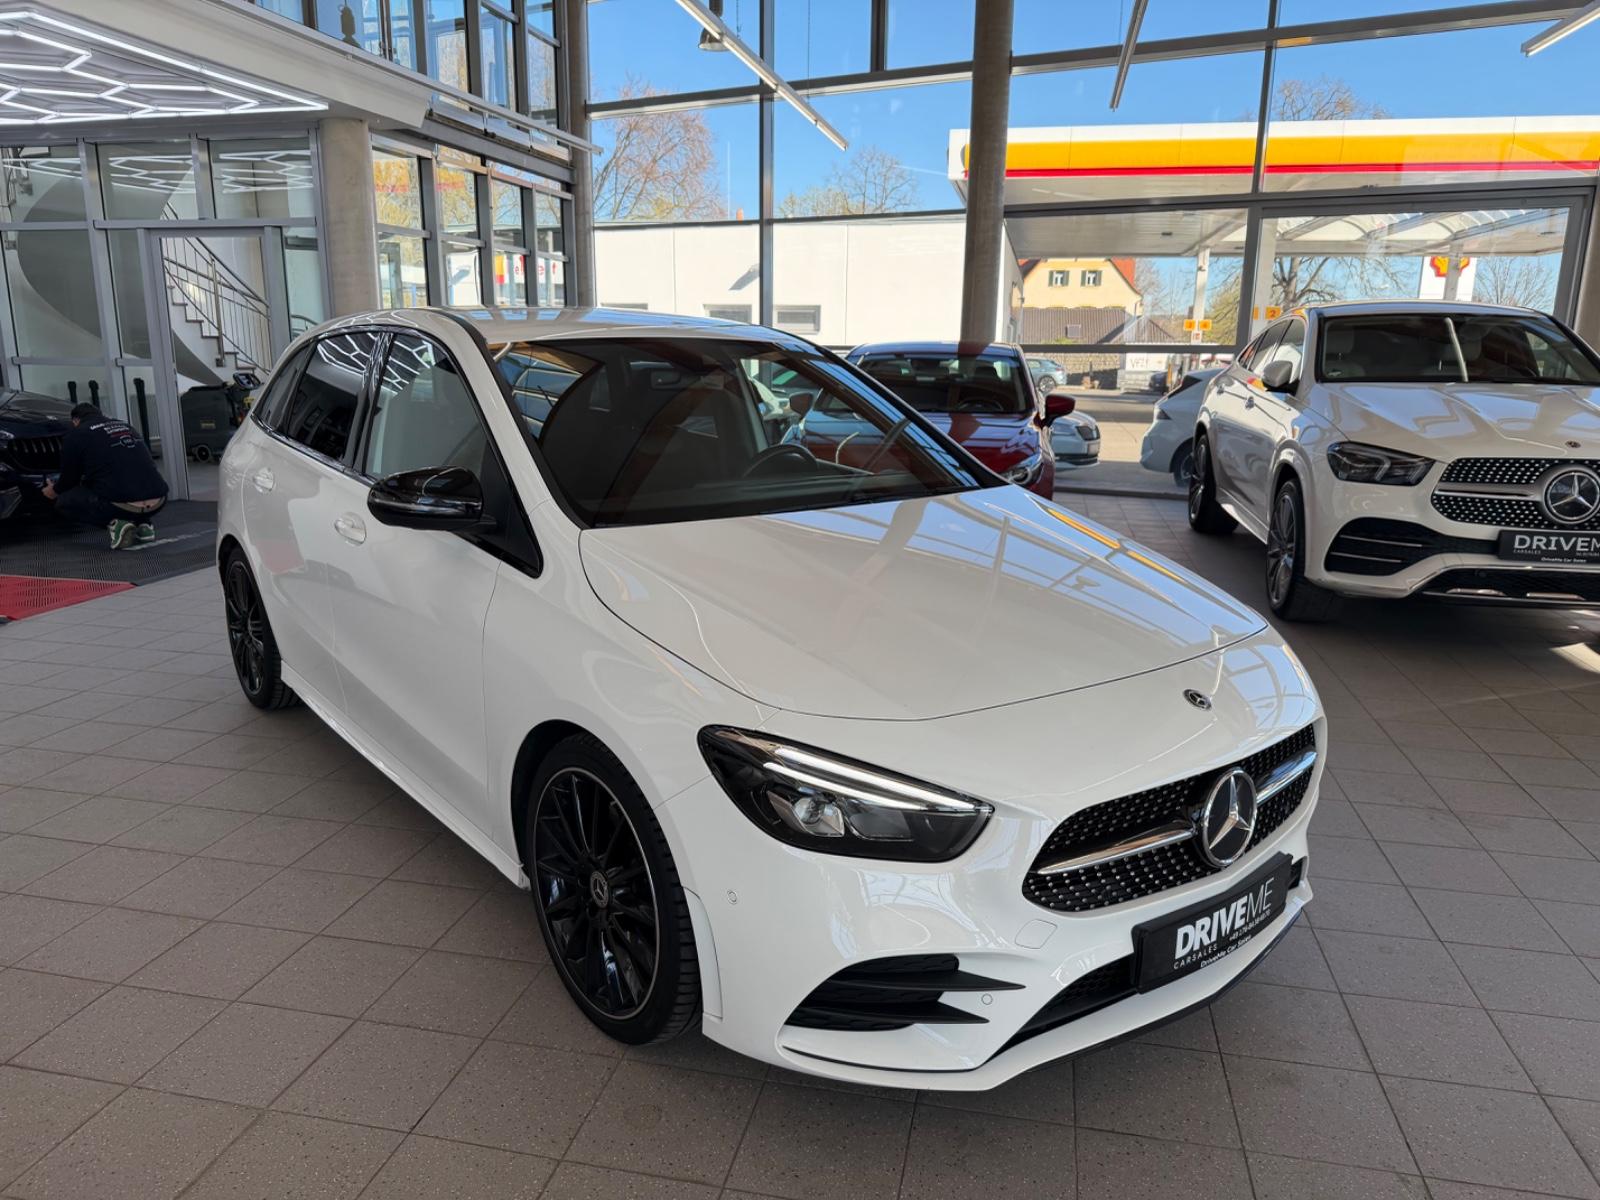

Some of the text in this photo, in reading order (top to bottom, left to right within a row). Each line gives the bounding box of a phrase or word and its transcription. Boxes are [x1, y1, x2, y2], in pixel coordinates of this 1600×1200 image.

[1174, 876, 1275, 960] DRIVEME
[1173, 943, 1218, 970] CARSALES
[1227, 943, 1238, 953] Car
